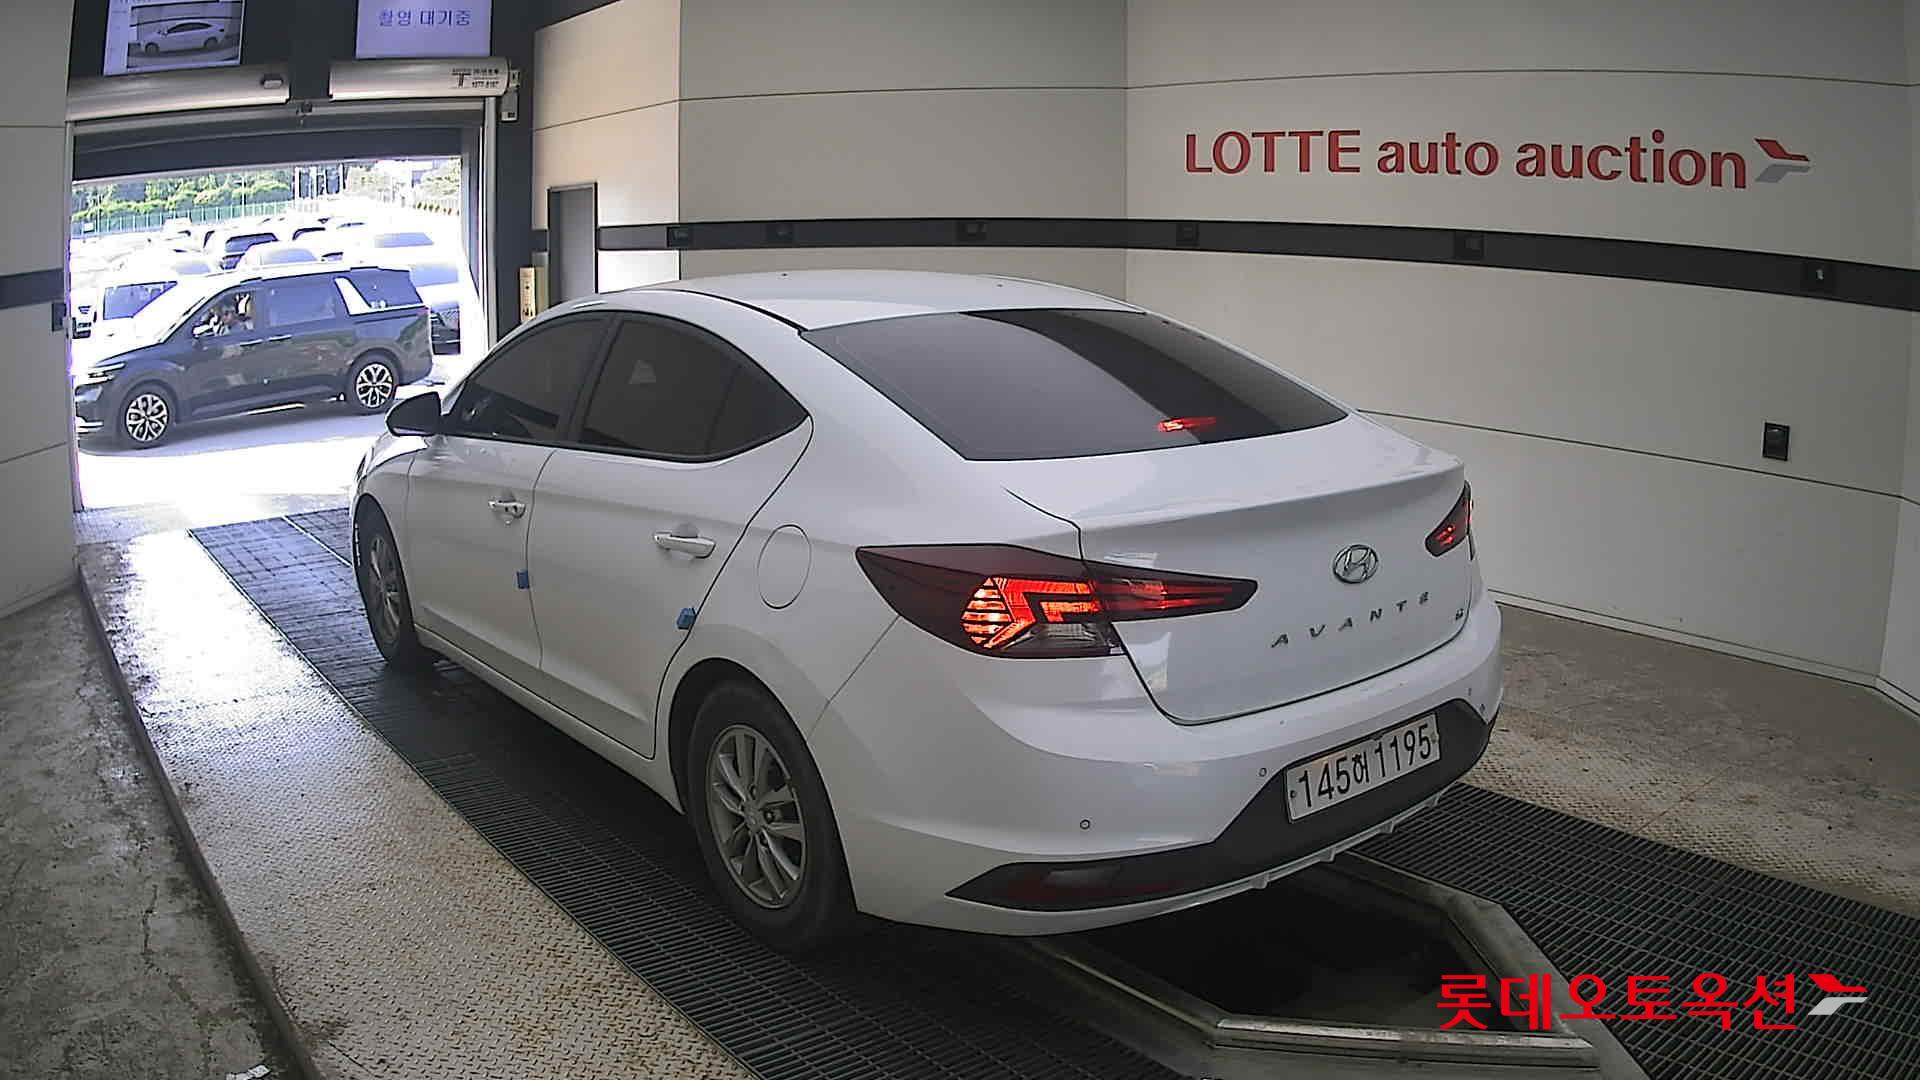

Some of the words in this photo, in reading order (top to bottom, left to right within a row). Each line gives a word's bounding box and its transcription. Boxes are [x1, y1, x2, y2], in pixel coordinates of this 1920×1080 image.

[419, 9, 472, 27] 대기중
[1185, 129, 1361, 174] LOTTE
[1377, 132, 1499, 176] auto
[1515, 129, 1747, 189] auction
[1271, 591, 1429, 648] AVANTE
